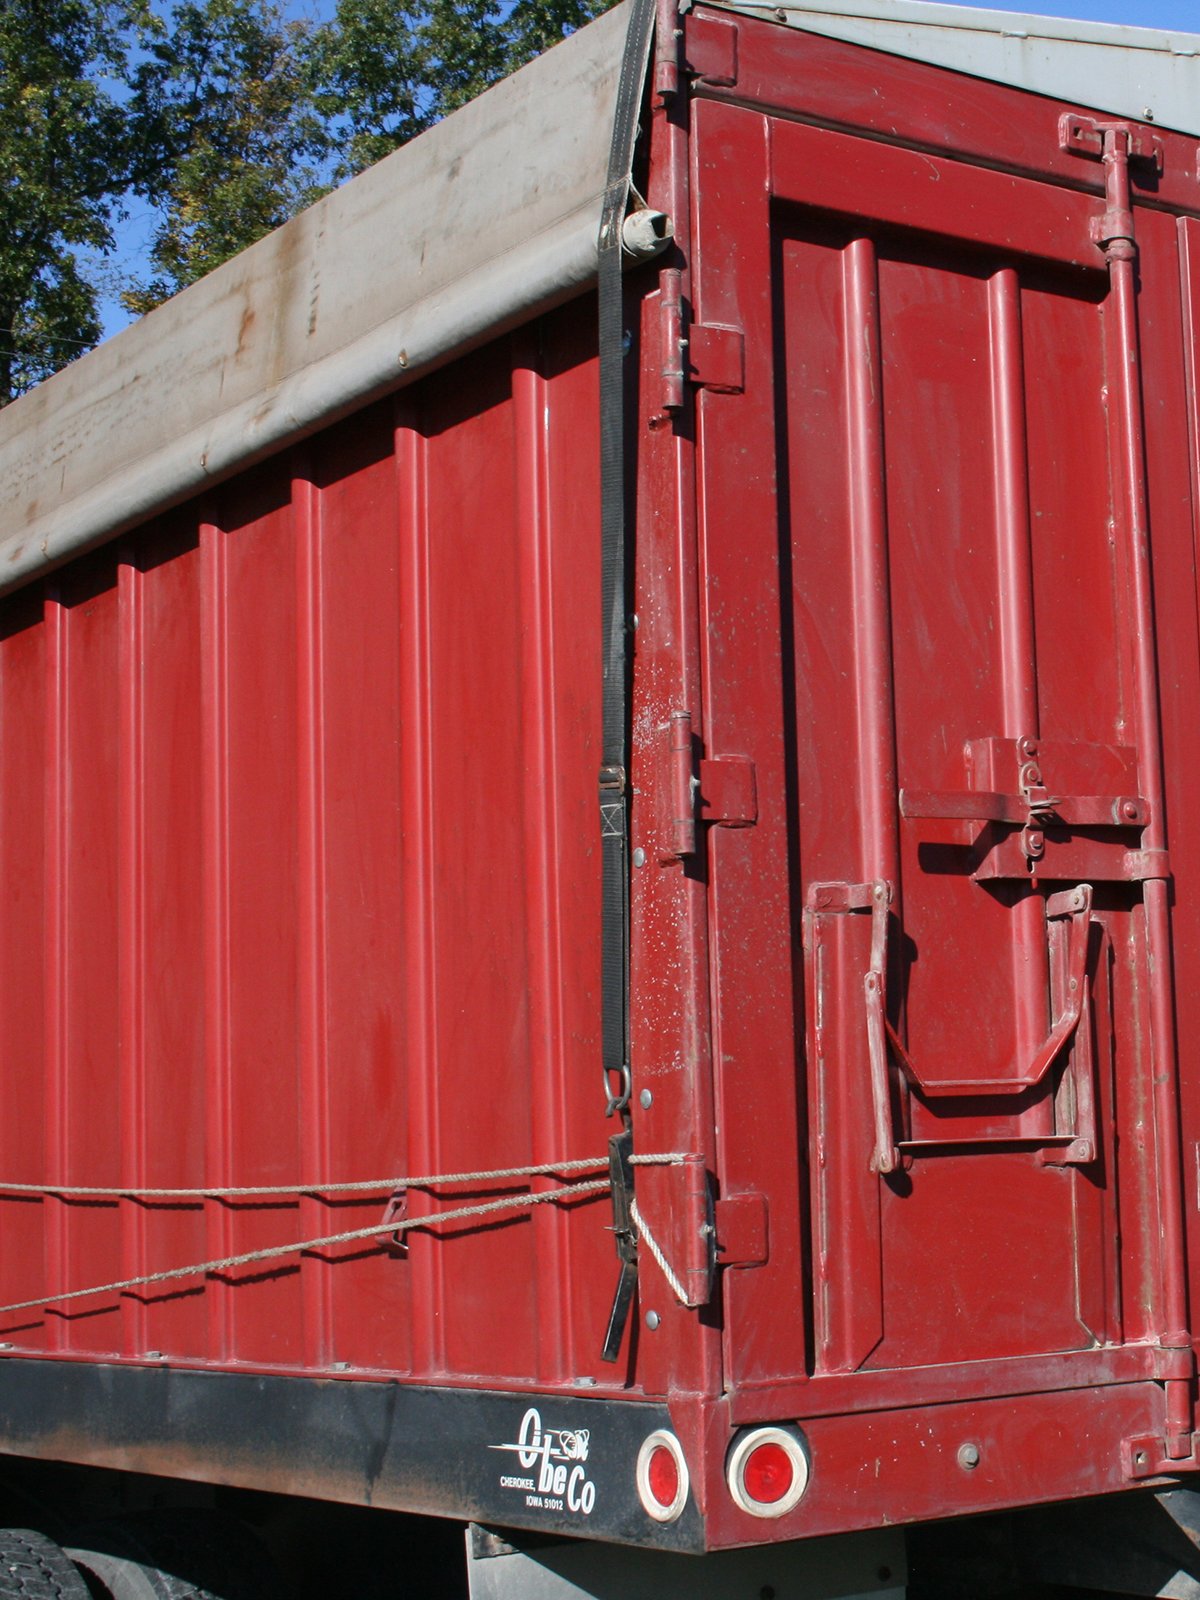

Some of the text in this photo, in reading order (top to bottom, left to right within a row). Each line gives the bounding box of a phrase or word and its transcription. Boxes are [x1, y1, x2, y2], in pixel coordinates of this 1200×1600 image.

[500, 1476, 536, 1492] CHEROKEE,
[526, 1495, 564, 1510] IOWA 51012
